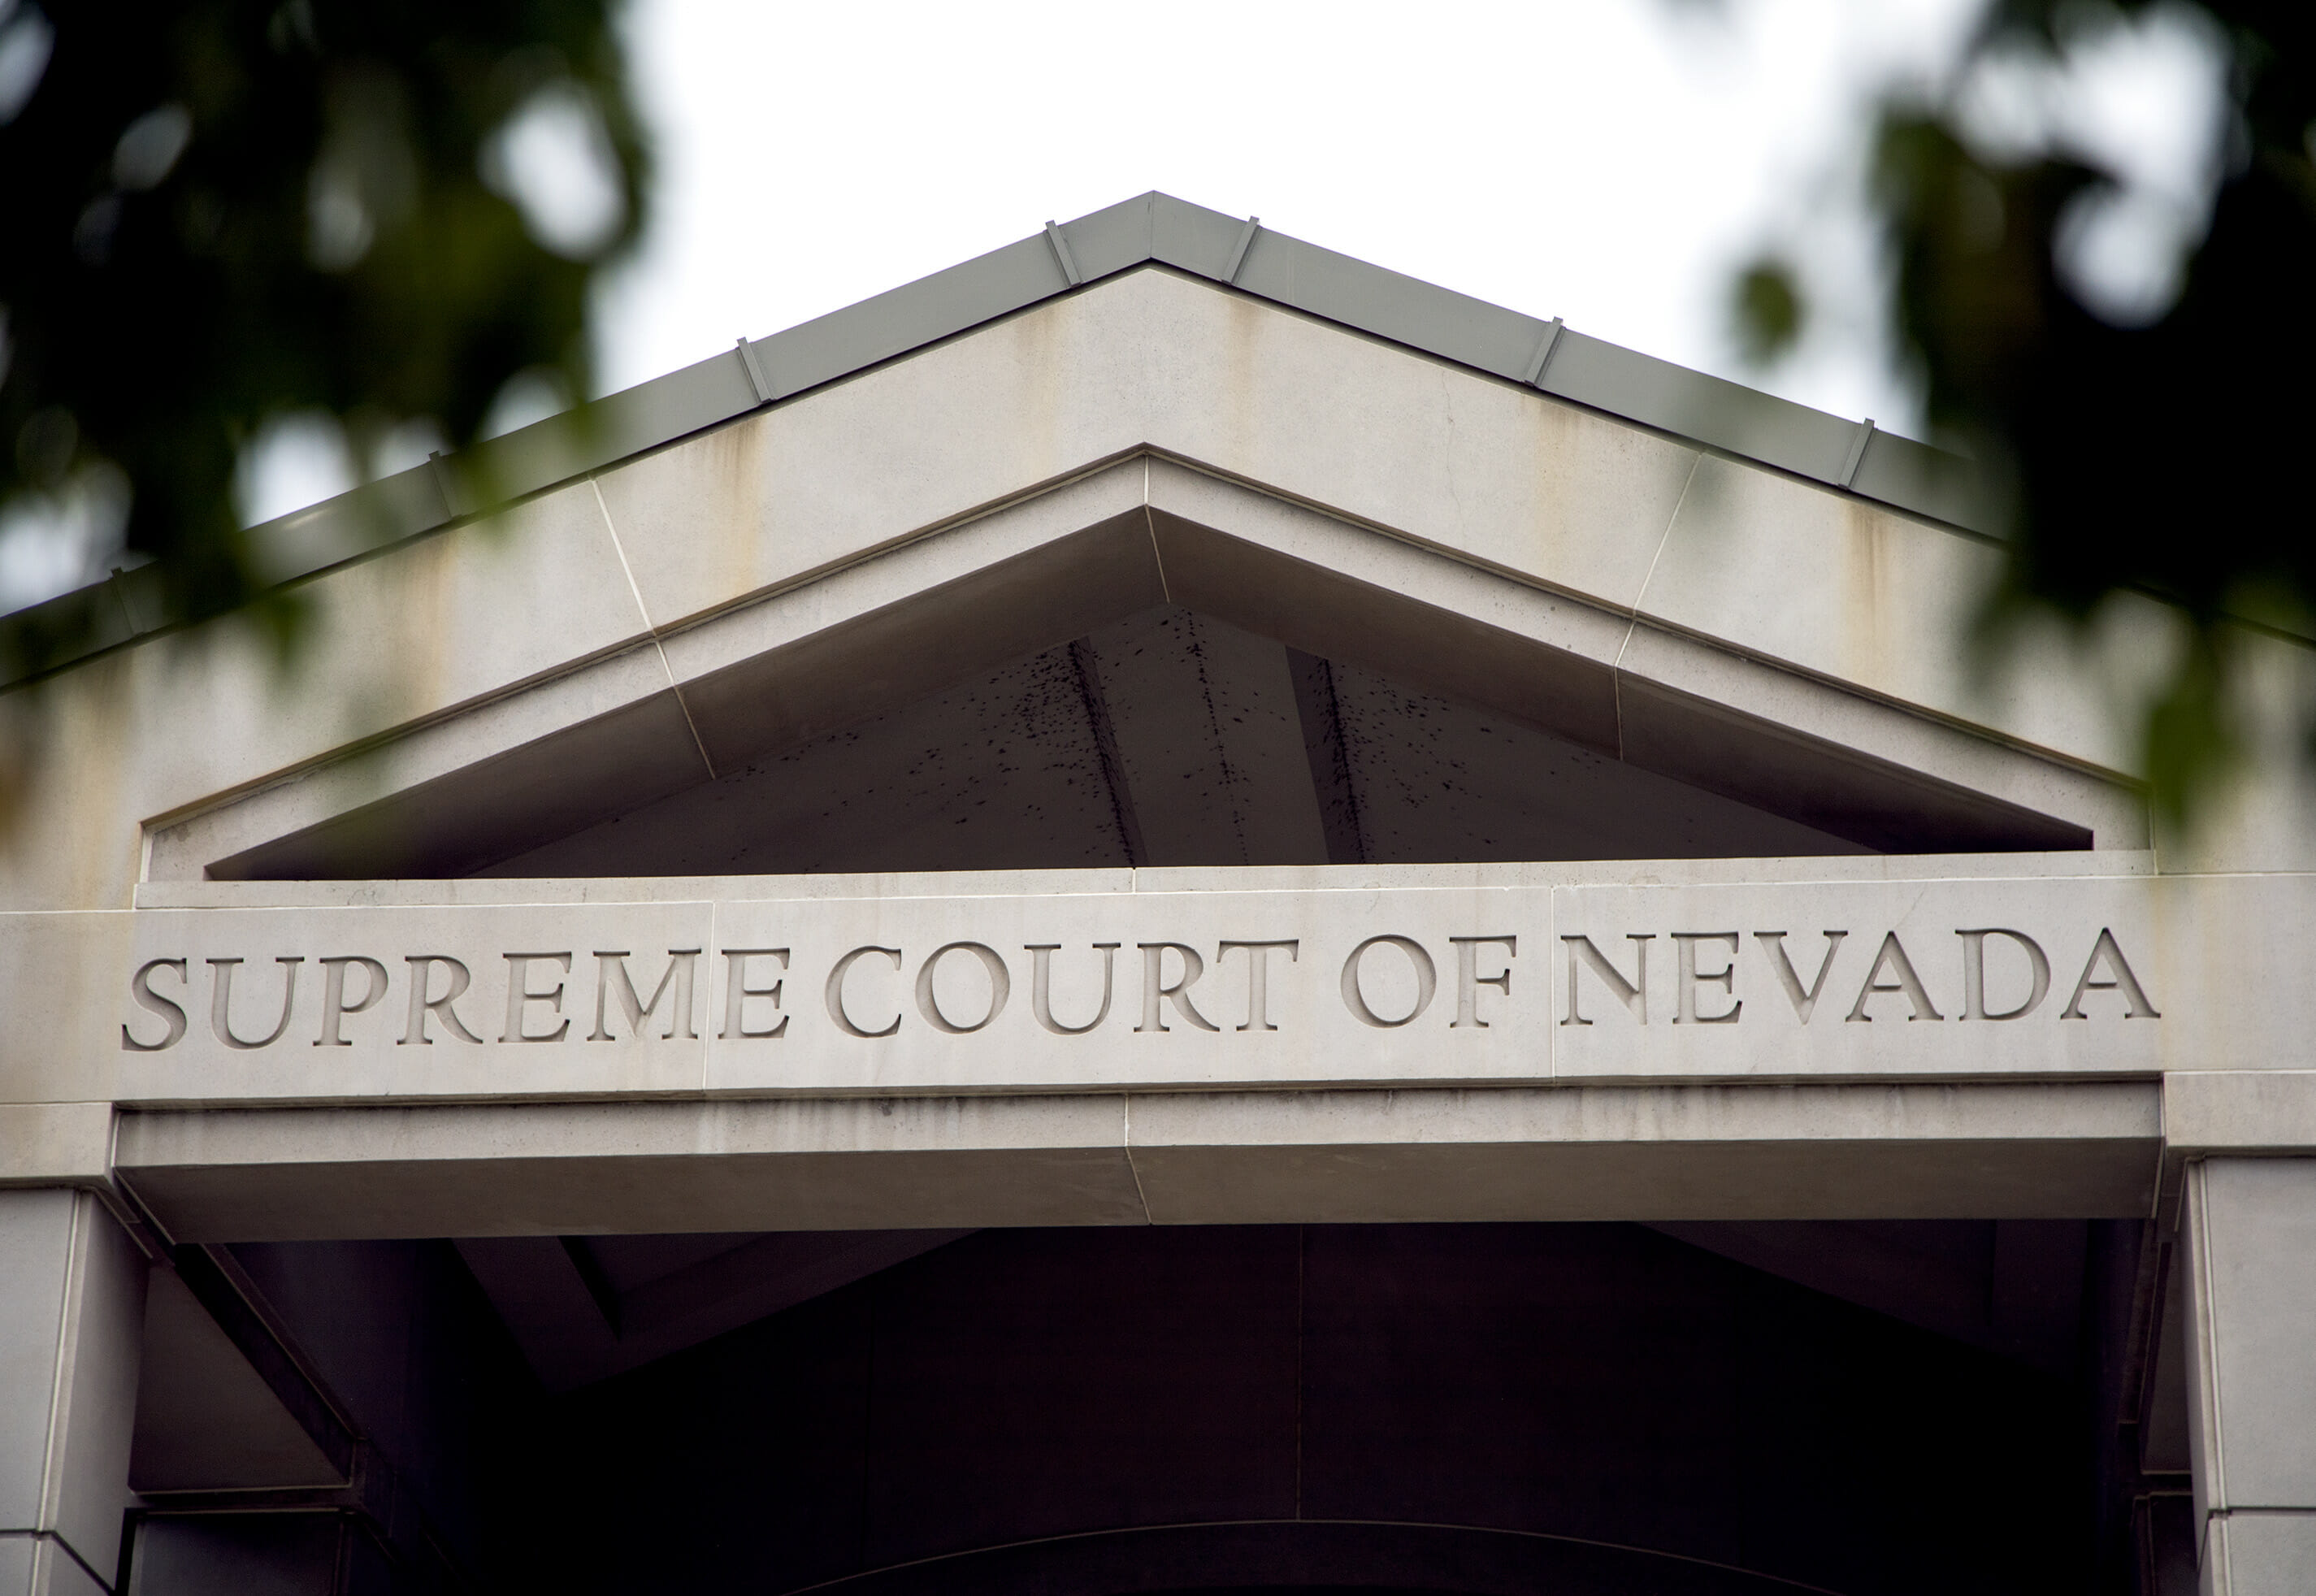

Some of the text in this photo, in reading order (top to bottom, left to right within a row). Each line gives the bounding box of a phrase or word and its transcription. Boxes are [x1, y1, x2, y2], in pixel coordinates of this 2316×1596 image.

[121, 926, 2162, 1052] SUPREME COURT OF NEVADA
